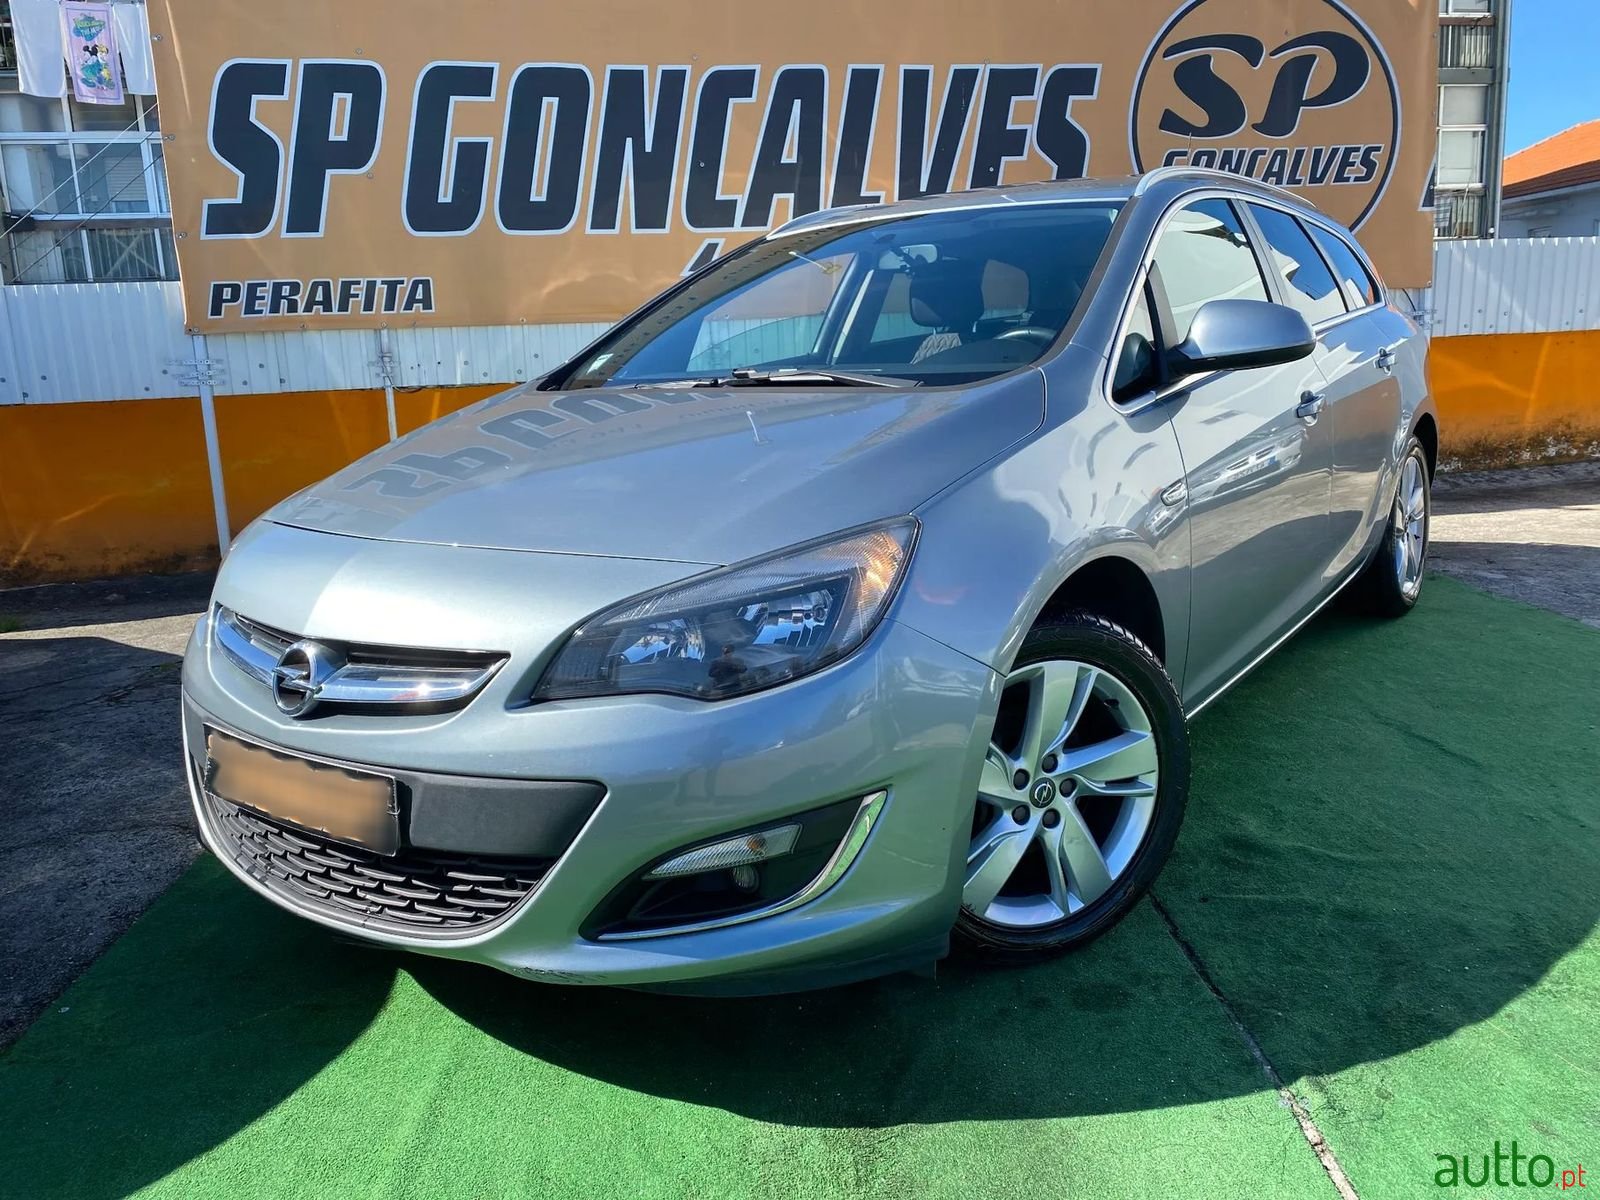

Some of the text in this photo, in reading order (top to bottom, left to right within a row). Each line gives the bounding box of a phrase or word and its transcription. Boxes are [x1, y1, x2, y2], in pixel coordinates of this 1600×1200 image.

[1159, 31, 1370, 139] SP
[200, 57, 387, 240] SP
[207, 277, 435, 318] PERAFITA
